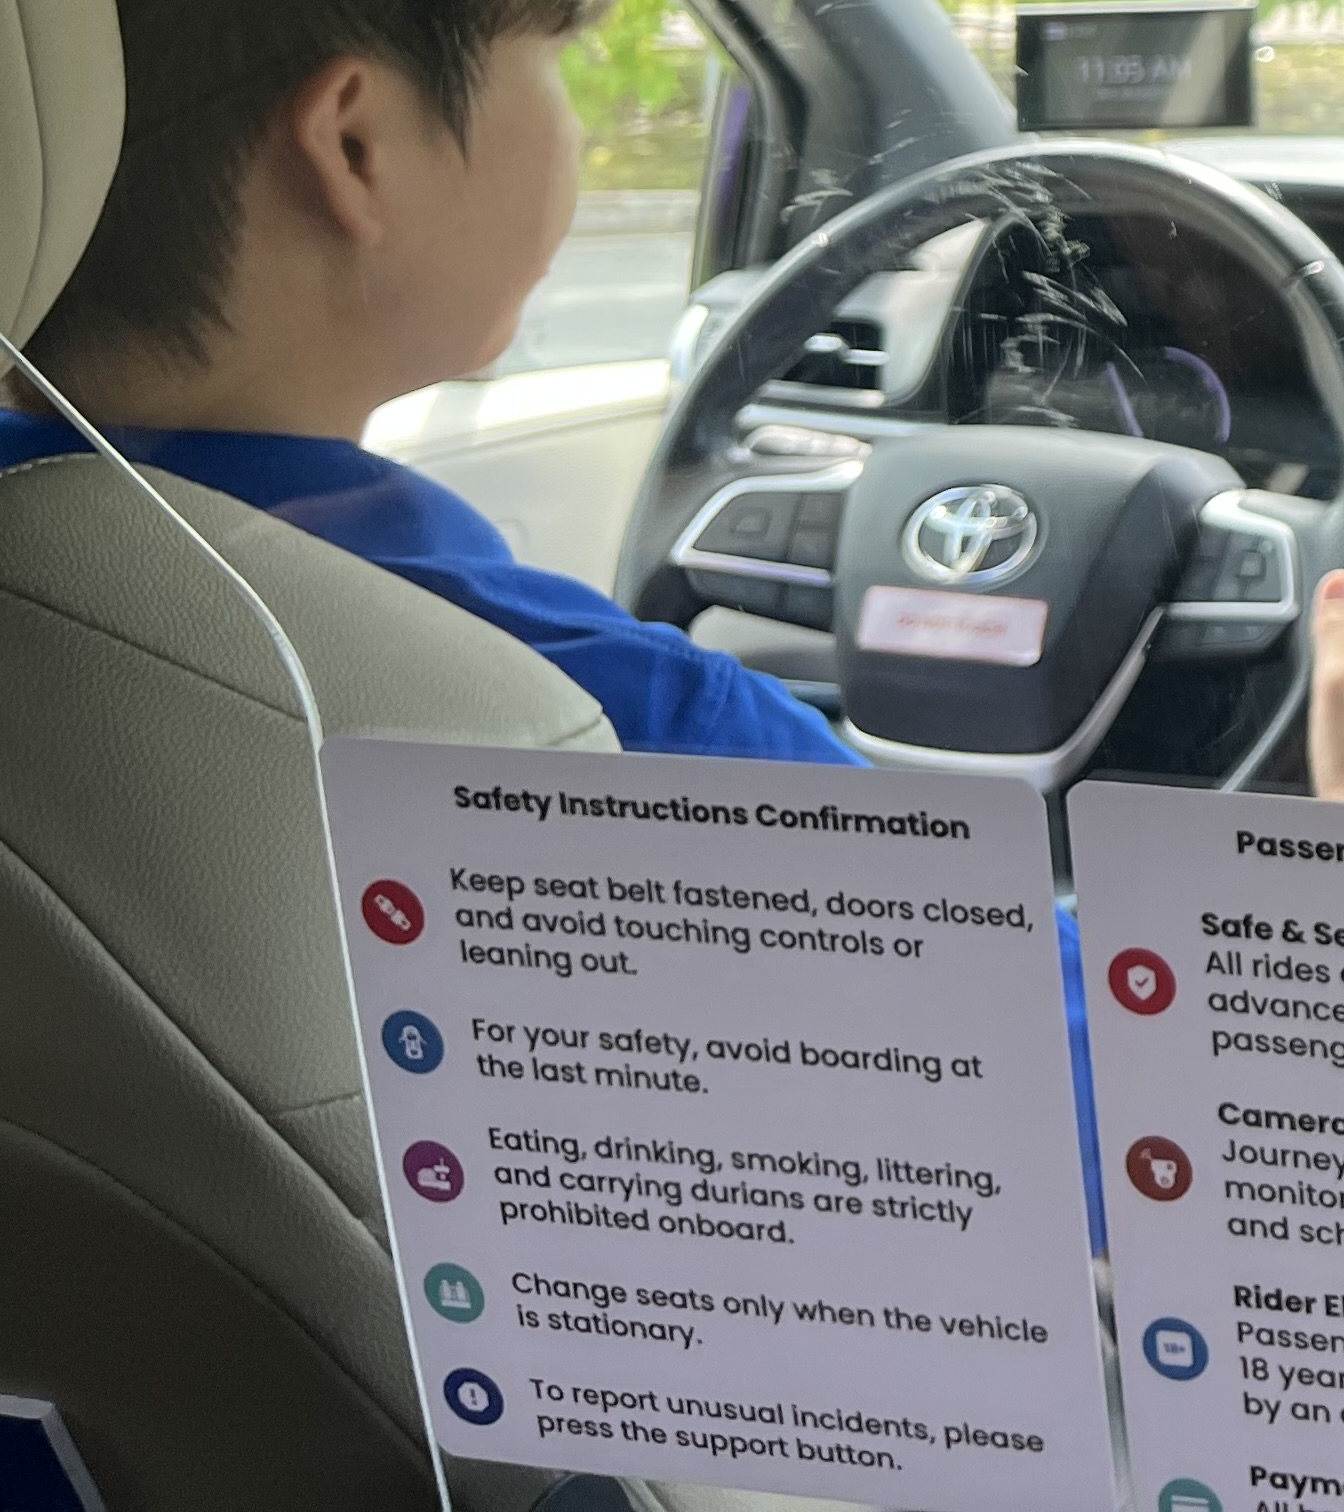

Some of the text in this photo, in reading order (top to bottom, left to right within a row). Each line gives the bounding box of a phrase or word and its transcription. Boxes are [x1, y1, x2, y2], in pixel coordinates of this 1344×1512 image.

[453, 785, 971, 840] Safety Instructions Confirmation
[449, 867, 1034, 933] Keep seat belt fastened, doors closed,
[455, 906, 924, 958] and avoid touching controls or
[1201, 912, 1274, 941] Safe
[1281, 919, 1306, 944] &
[460, 939, 638, 979] leaning out.
[1205, 950, 1243, 976] All
[1252, 953, 1331, 984] rides
[471, 1018, 984, 1084] For your safety, avoid boarding at
[476, 1054, 709, 1094] the last minute.
[488, 1127, 1001, 1198] Eating, drinking, smoking, littering,
[493, 1165, 973, 1232] and carrying durians are strictly
[499, 1199, 795, 1244] prohibited onboard.
[1227, 1216, 1290, 1241] and
[511, 1272, 1048, 1344] Change seats only when the vehicle
[1233, 1284, 1317, 1315] Rider
[516, 1303, 703, 1350] is stationary.
[1239, 1355, 1270, 1382] 18
[529, 1378, 1044, 1453] To report unusual incidents, please
[1243, 1391, 1281, 1425] by
[1290, 1402, 1331, 1424] an
[536, 1415, 903, 1471] press the support button.
